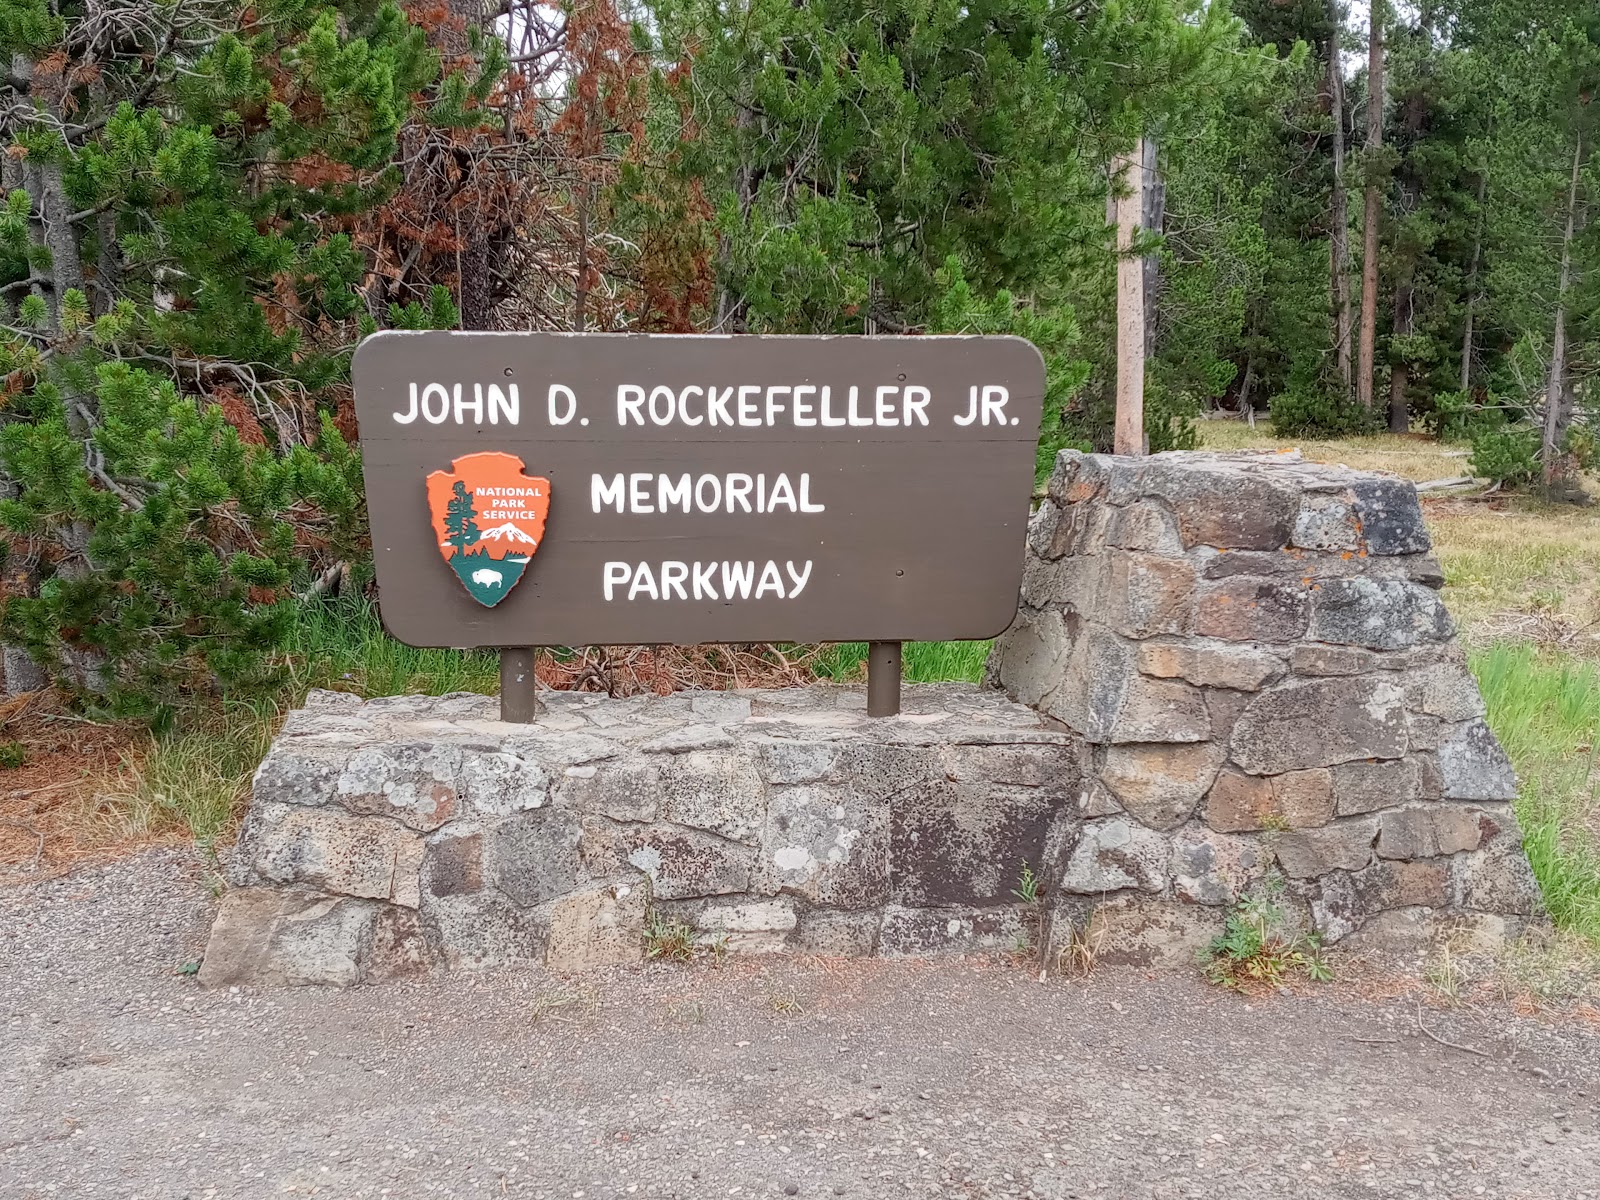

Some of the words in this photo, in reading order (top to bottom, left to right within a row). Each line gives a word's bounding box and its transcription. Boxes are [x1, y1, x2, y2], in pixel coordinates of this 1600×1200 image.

[393, 382, 520, 426] JOHN
[547, 383, 590, 427] D.
[616, 384, 932, 428] ROCKEFELLER
[953, 384, 1020, 427] JR.
[476, 487, 542, 497] NATIONAL
[492, 499, 526, 508] PARK
[590, 472, 826, 514] MEMORIAL
[482, 510, 536, 520] SERVICE
[603, 559, 813, 602] PARKWAY
